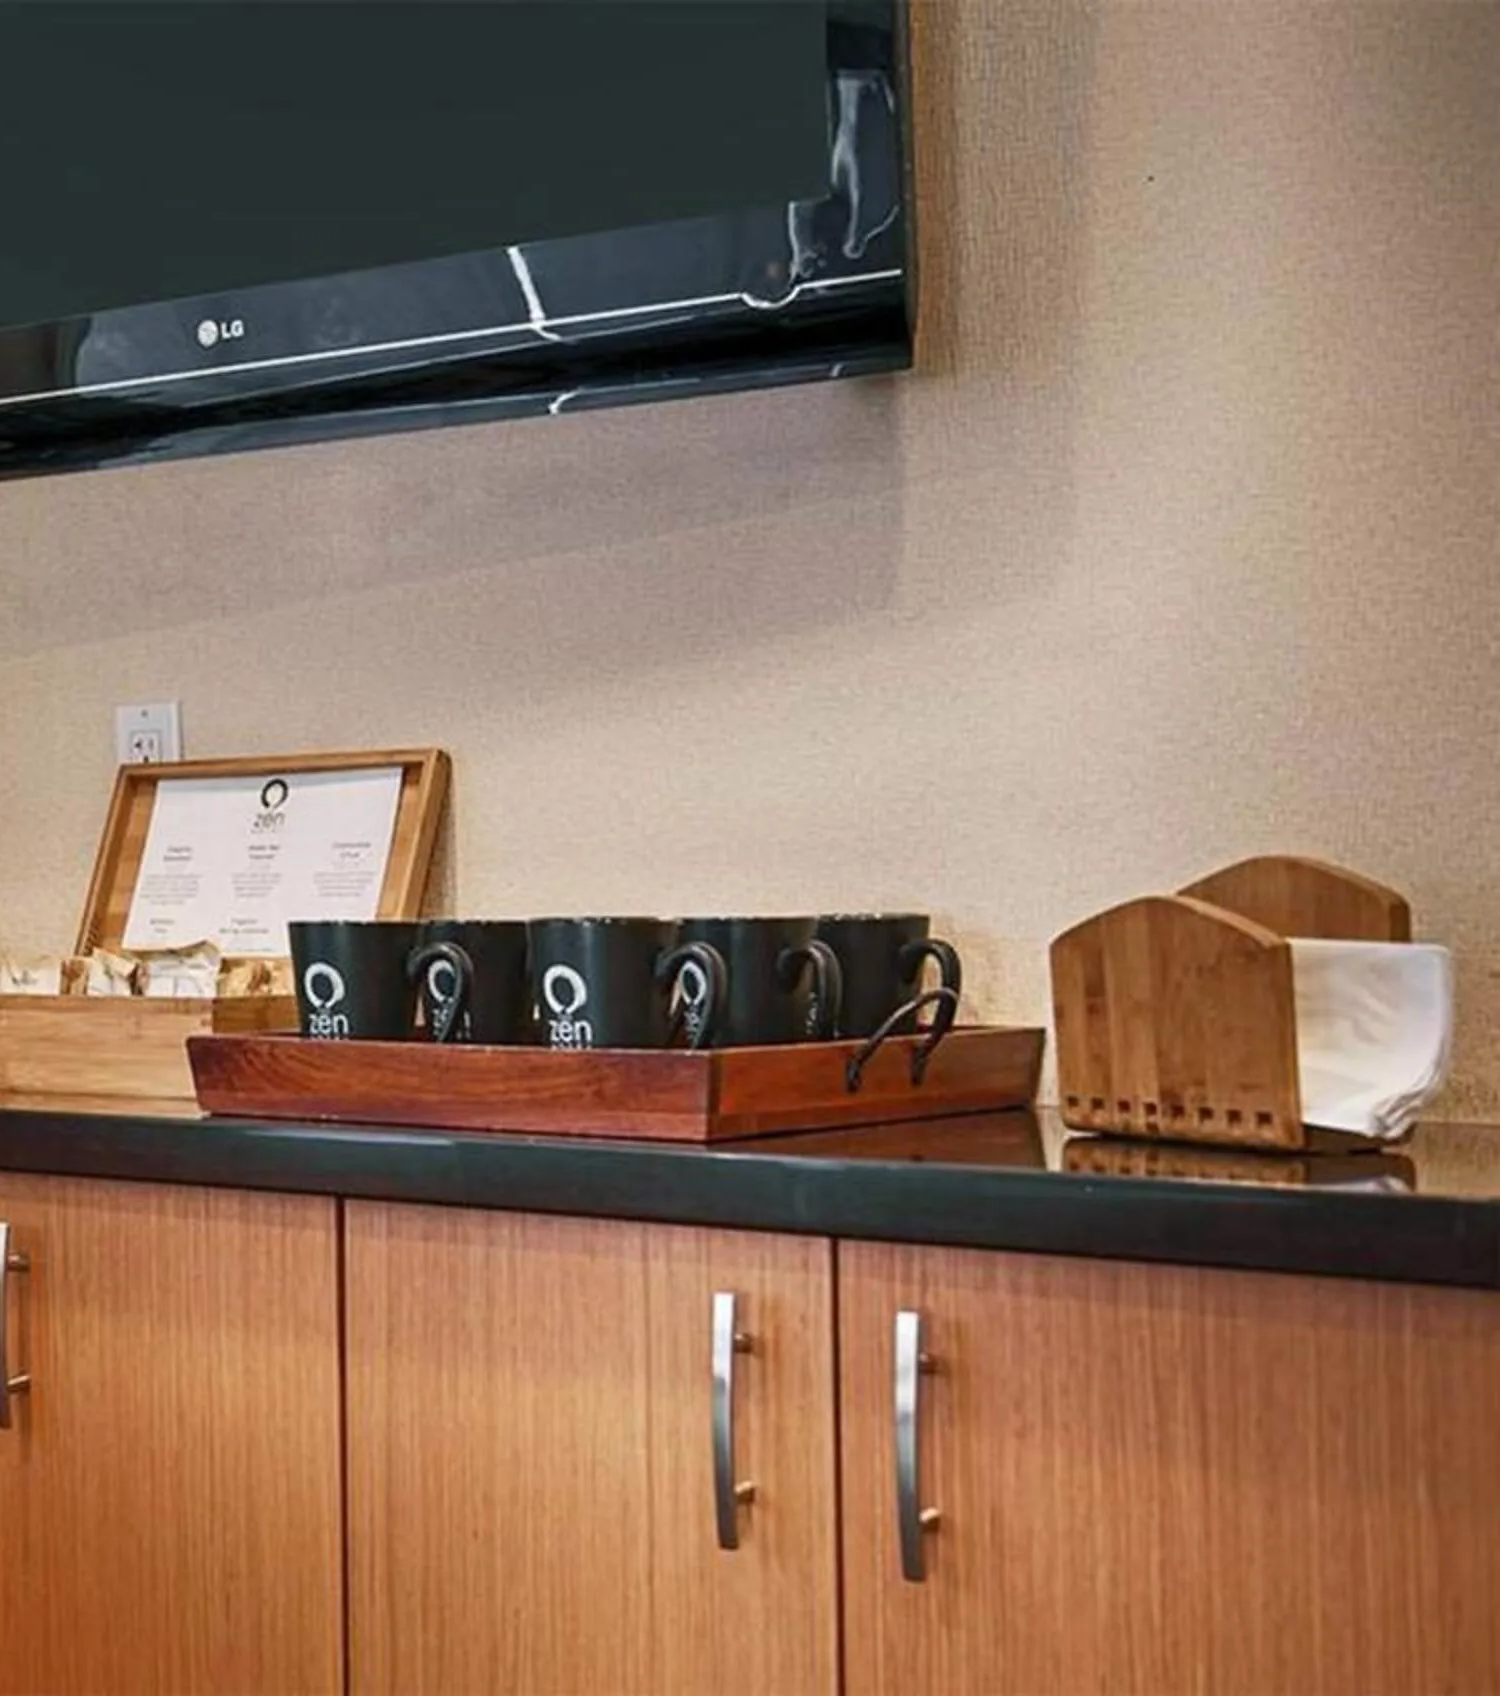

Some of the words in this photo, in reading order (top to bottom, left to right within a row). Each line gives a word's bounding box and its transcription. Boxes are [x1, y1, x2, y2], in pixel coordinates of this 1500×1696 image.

[221, 319, 244, 339] LG
[308, 1013, 349, 1034] zen
[549, 1019, 592, 1041] zen
